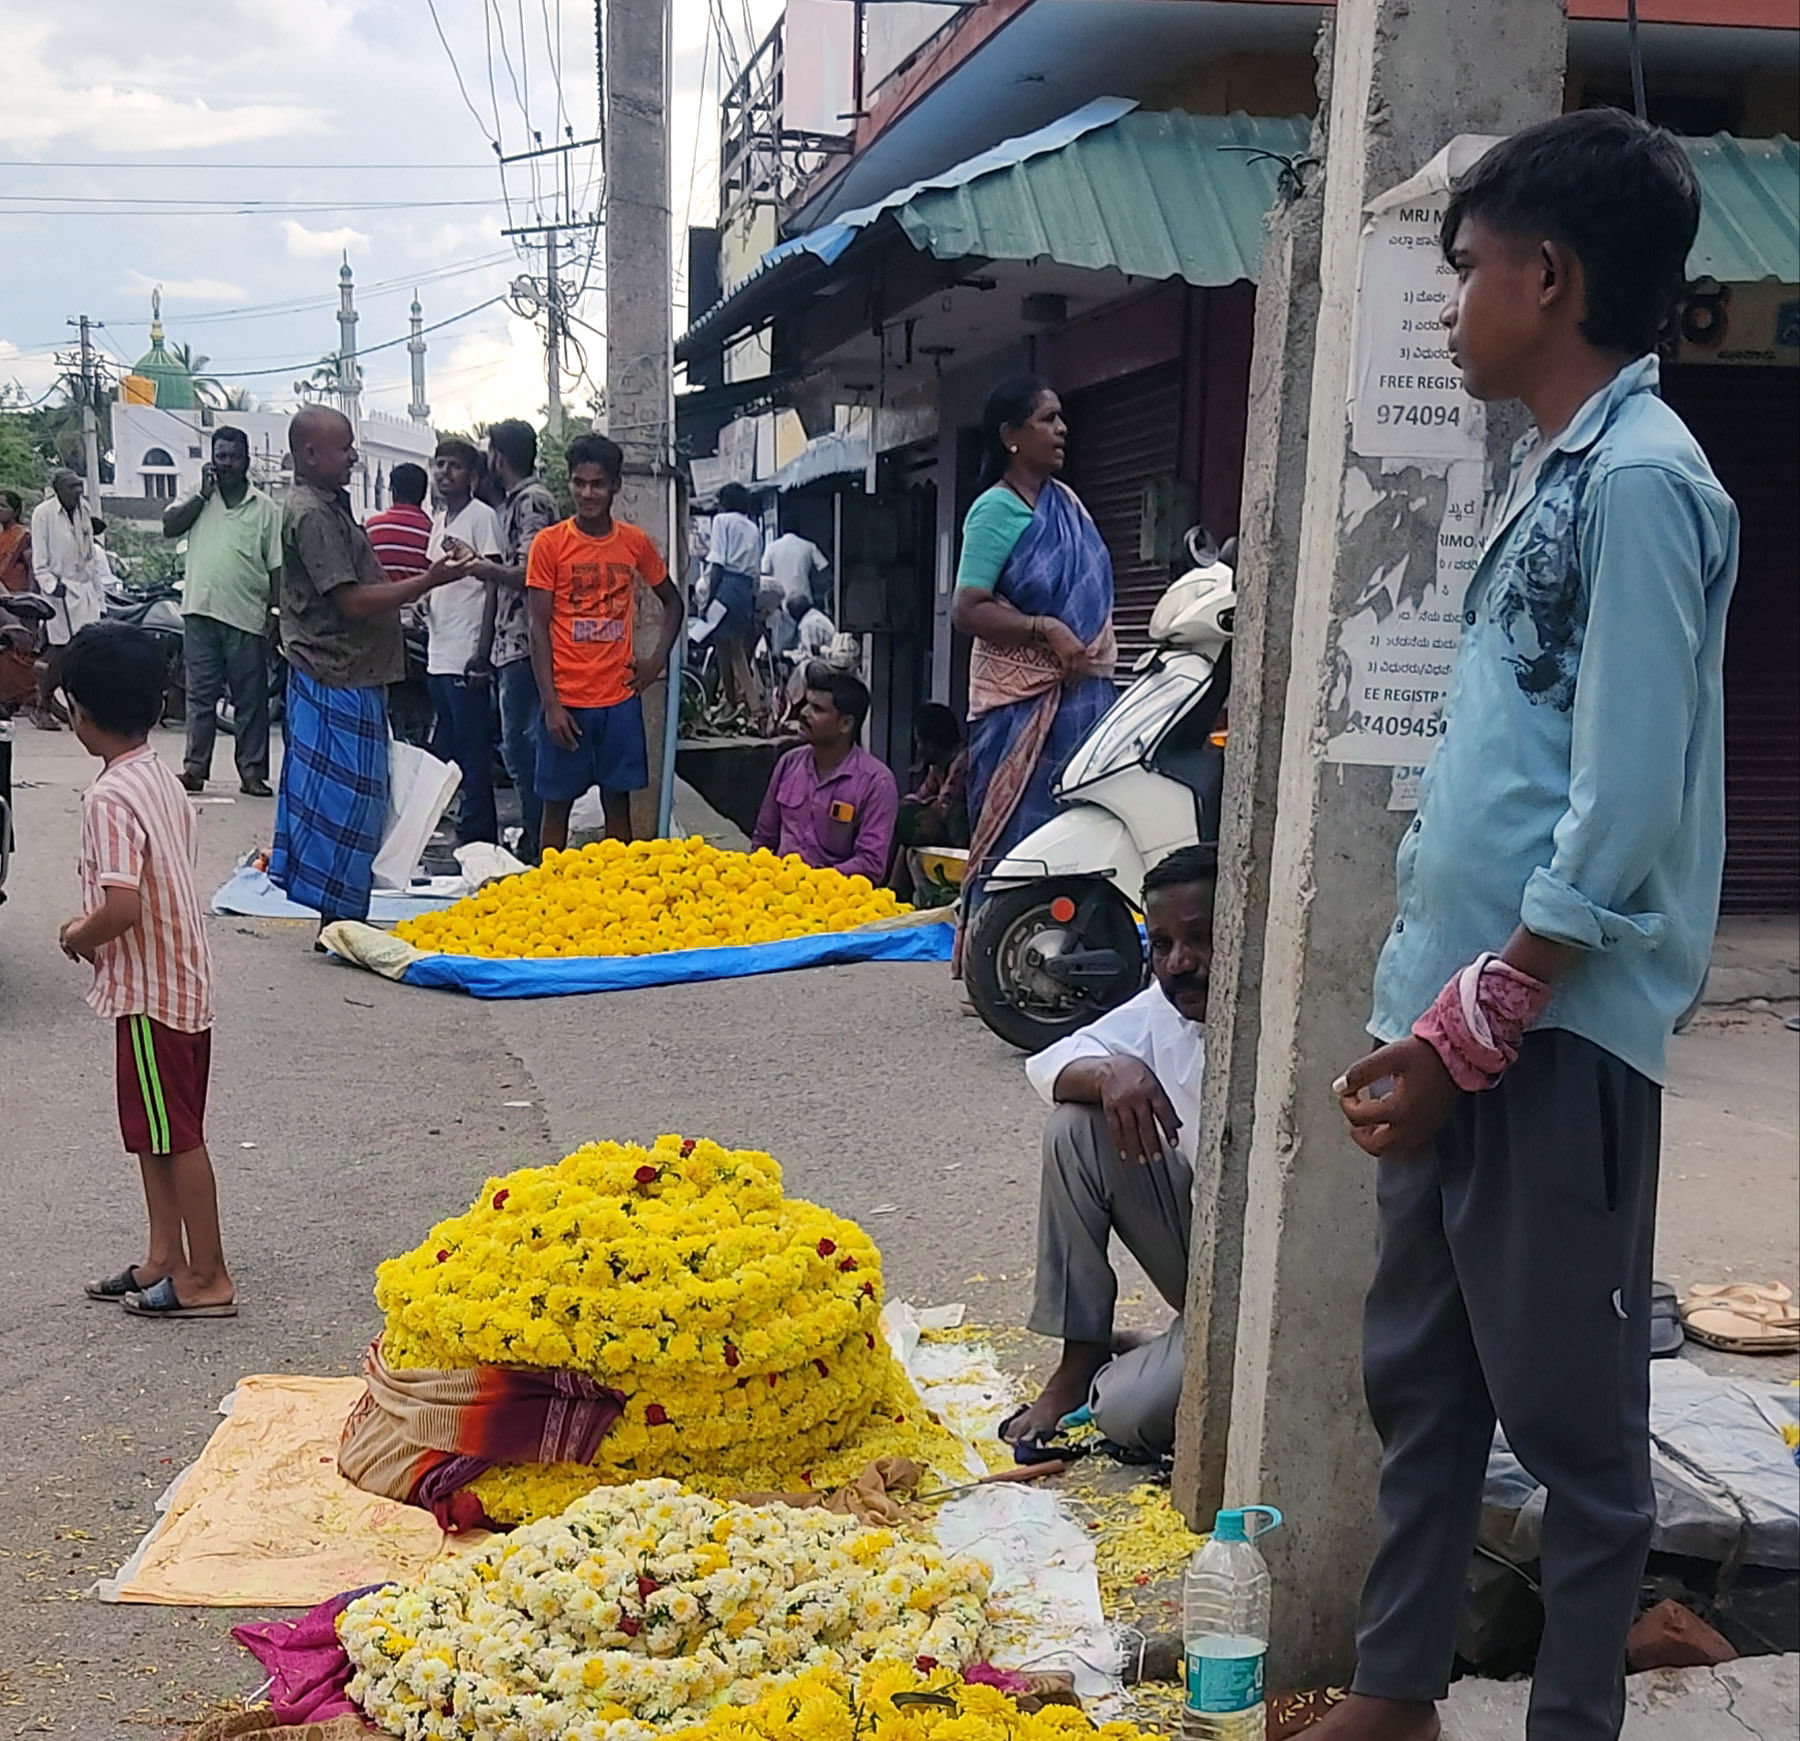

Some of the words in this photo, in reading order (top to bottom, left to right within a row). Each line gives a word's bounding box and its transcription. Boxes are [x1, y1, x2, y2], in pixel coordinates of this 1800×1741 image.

[1399, 208, 1430, 222] MRJ
[1403, 290, 1414, 304] 1)
[1401, 320, 1412, 332] 2)
[1399, 347, 1410, 360] 3)
[1379, 374, 1414, 389] FREE
[1376, 404, 1460, 427] 974094
[1369, 635, 1380, 646] 2)
[1367, 661, 1378, 674] 3)
[1364, 687, 1380, 700] EE
